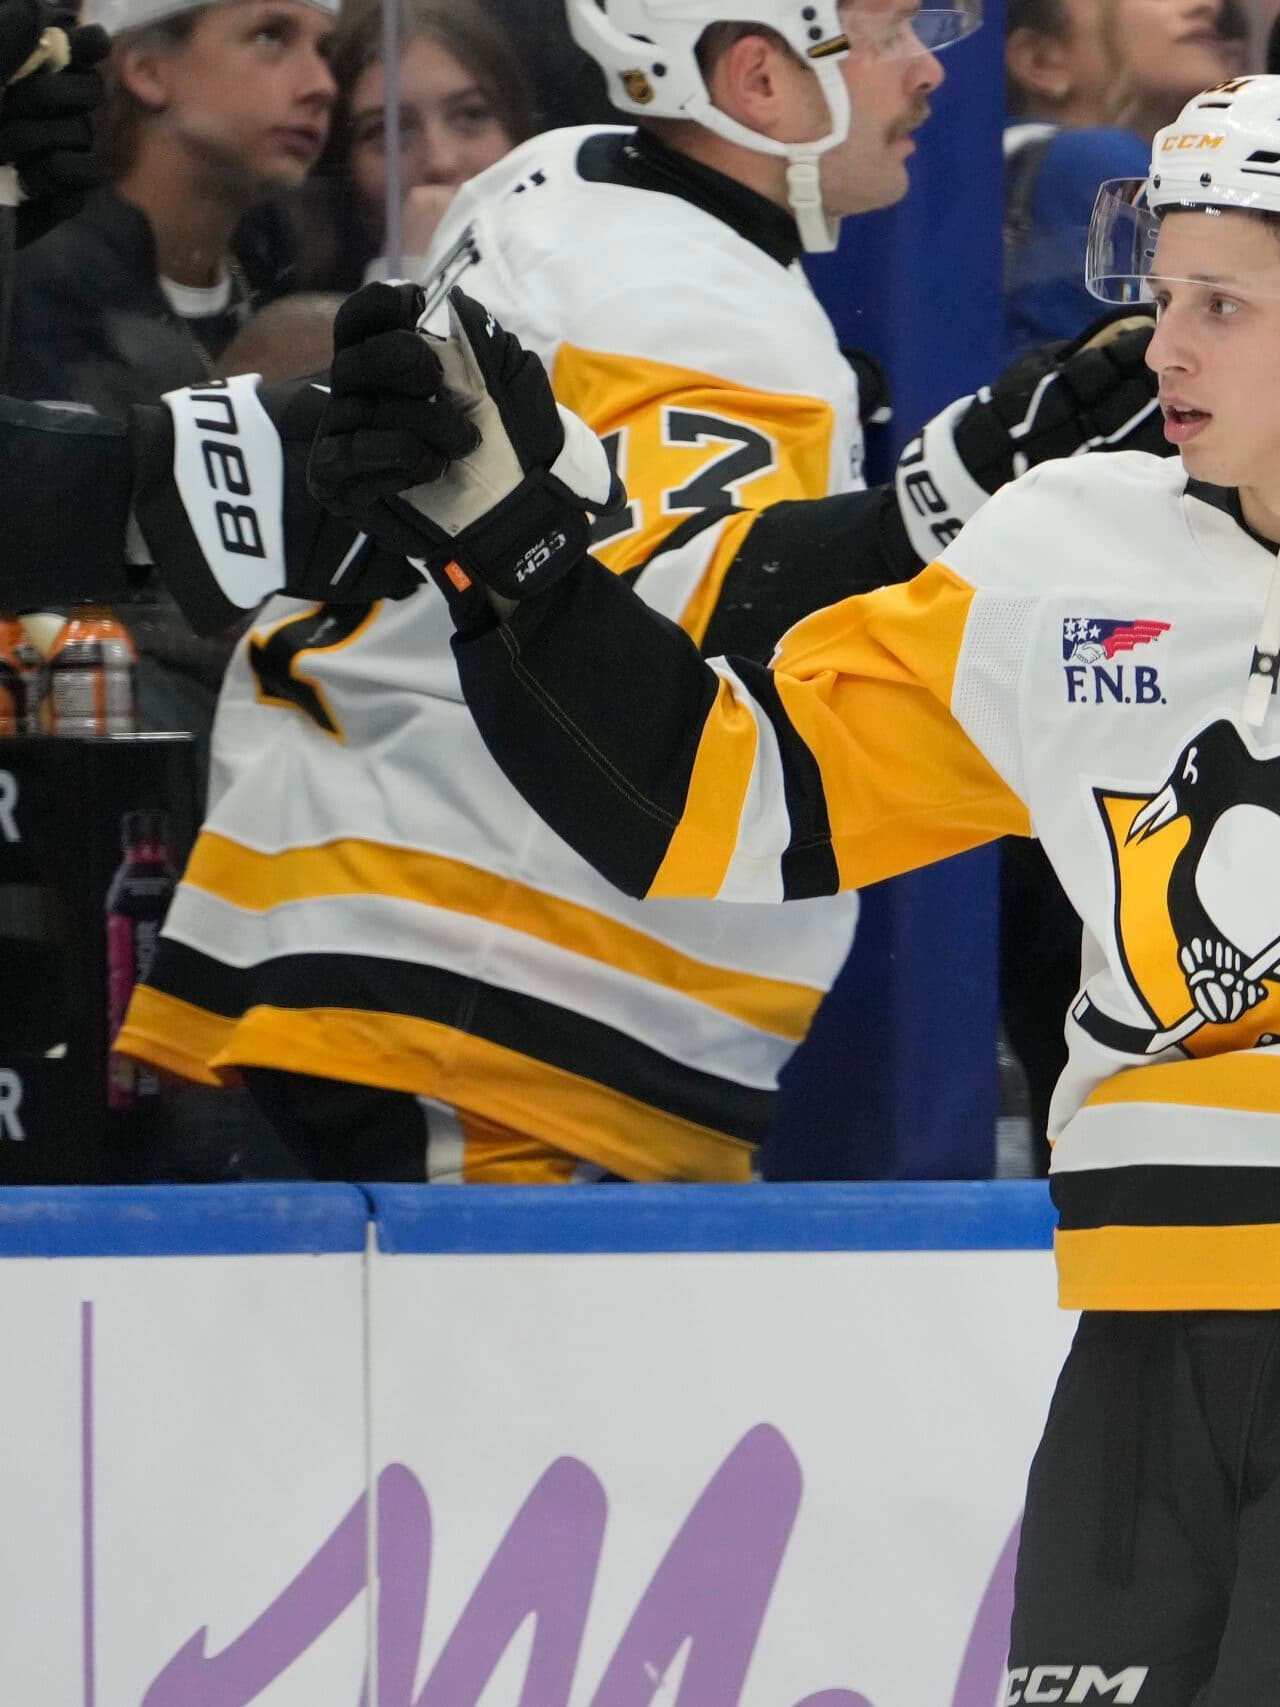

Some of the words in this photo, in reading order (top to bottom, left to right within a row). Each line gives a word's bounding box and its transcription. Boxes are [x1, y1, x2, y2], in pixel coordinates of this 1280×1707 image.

[1161, 133, 1225, 152] CCM
[1064, 665, 1167, 705] F.N.B.
[1007, 1664, 1150, 1707] CCM
